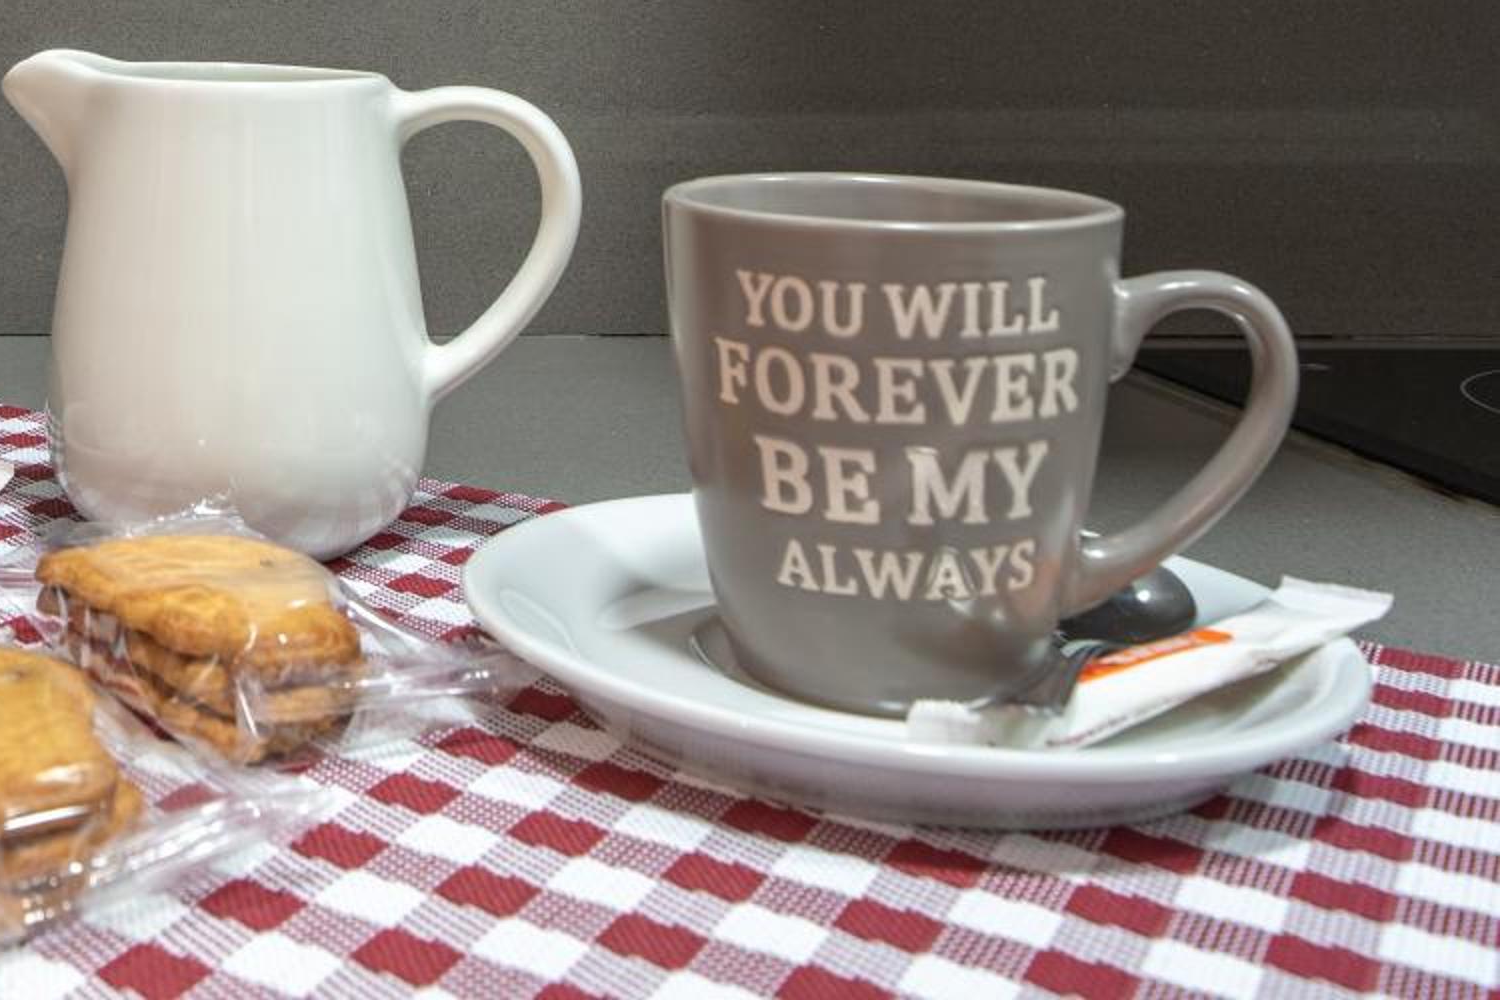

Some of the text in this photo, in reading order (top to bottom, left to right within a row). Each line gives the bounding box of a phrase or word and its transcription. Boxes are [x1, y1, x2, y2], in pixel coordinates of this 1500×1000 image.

[736, 269, 1060, 340] YOU WILL
[714, 336, 1080, 426] FOREVER
[753, 434, 1049, 526] BE MY
[777, 538, 1036, 601] ALWAYS
